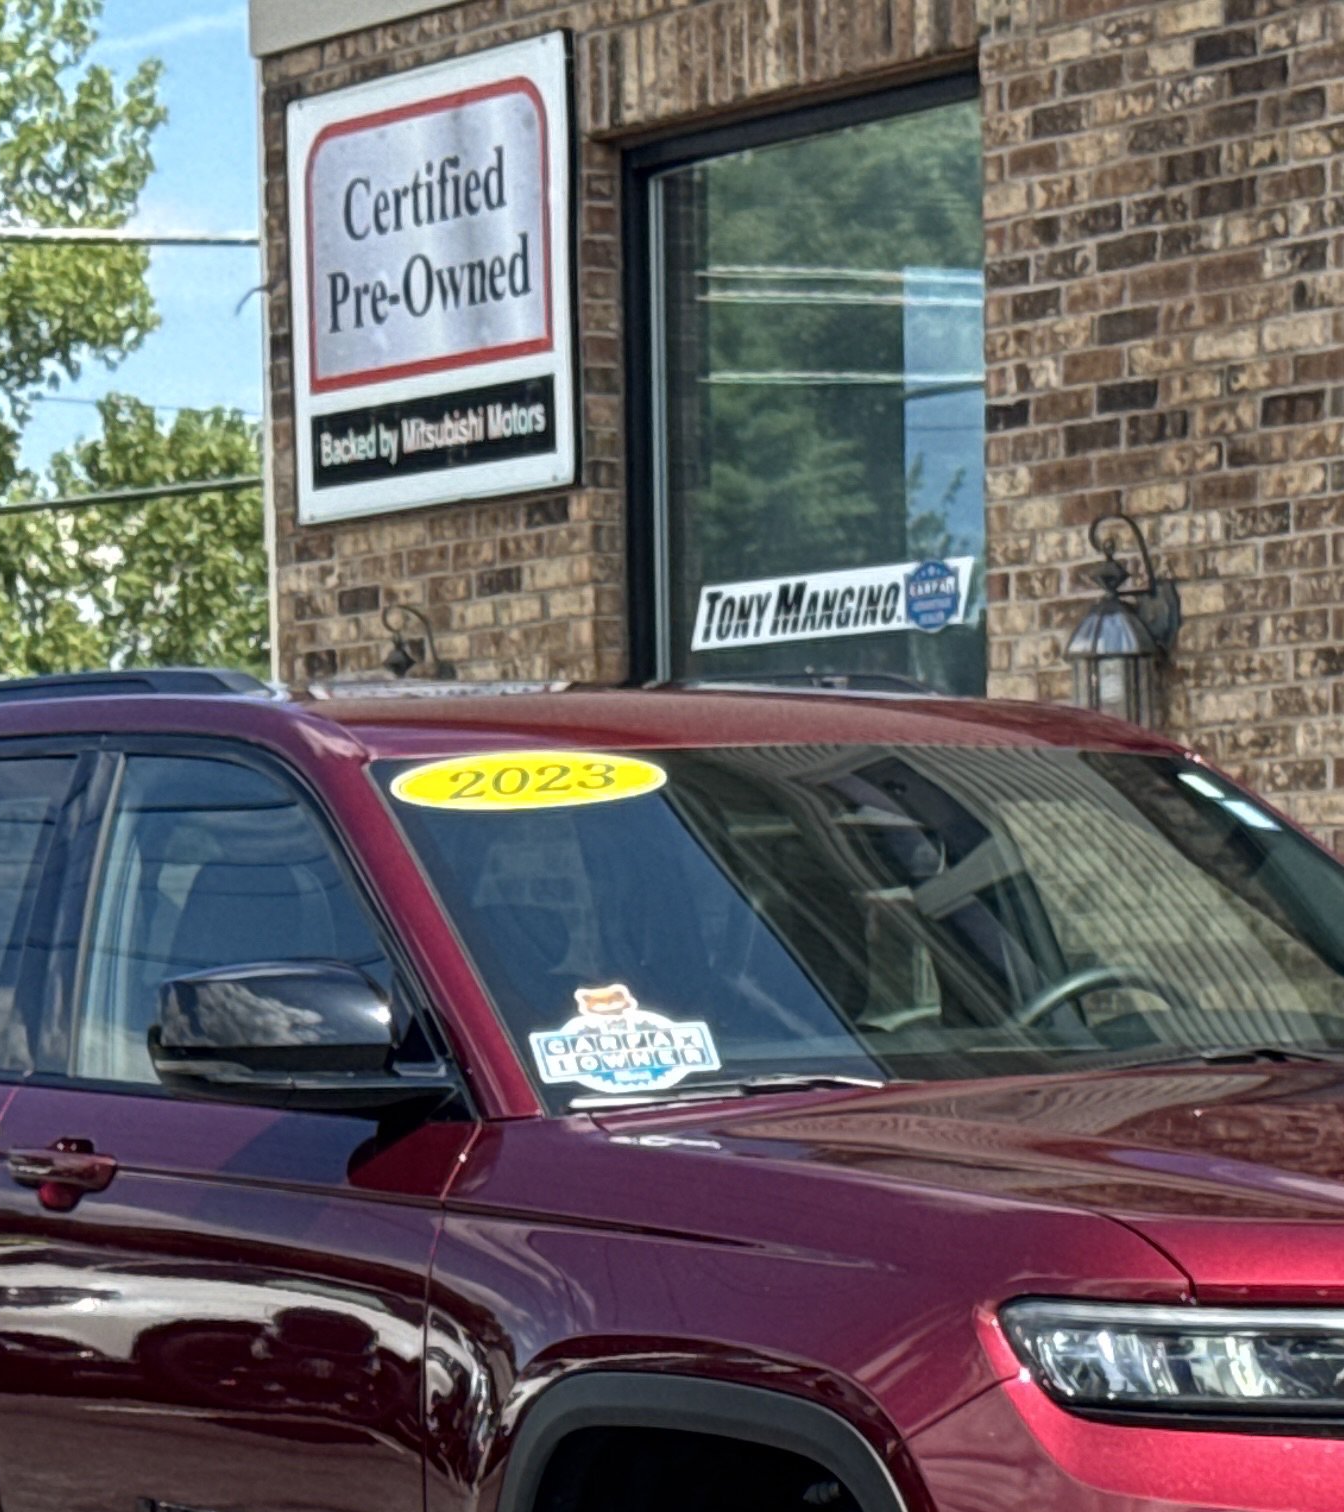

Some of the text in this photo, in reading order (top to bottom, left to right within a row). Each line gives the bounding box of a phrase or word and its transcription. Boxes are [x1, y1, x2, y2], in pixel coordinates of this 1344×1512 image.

[343, 144, 507, 241] Certified
[327, 231, 532, 334] Pre-Owned
[319, 401, 546, 467] Backed by Mitsubishi Motors
[702, 591, 772, 643] TONY
[448, 763, 616, 799] 2023
[543, 1031, 698, 1055] CARFAX
